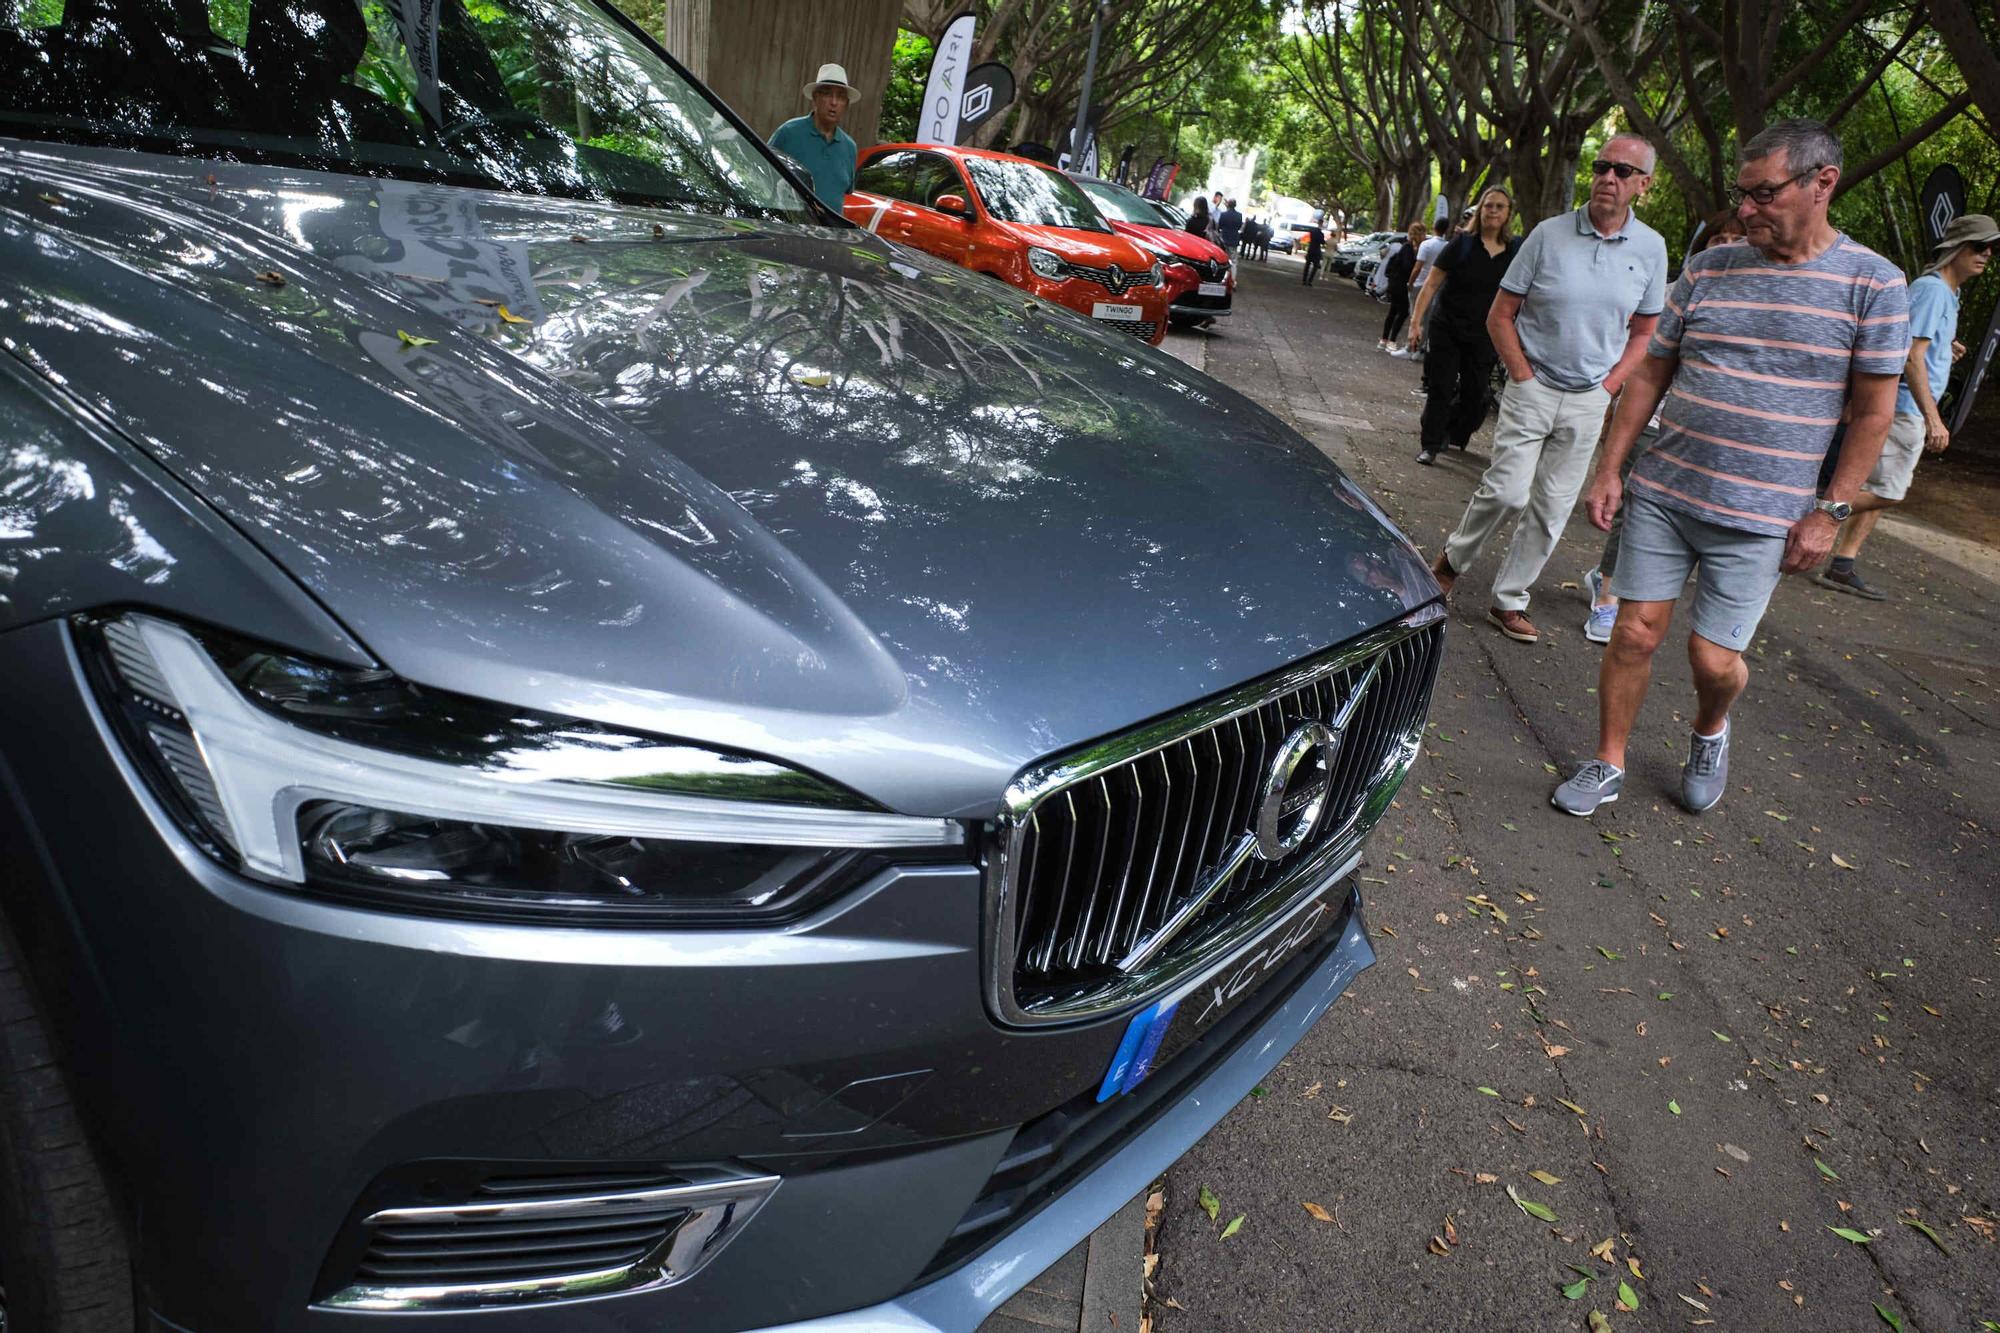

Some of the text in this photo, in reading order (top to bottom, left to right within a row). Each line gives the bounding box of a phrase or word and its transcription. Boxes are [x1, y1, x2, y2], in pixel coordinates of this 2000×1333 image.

[1104, 304, 1134, 315] TWINGO
[1194, 902, 1327, 1025] XC60
[1112, 1060, 1129, 1082] E
